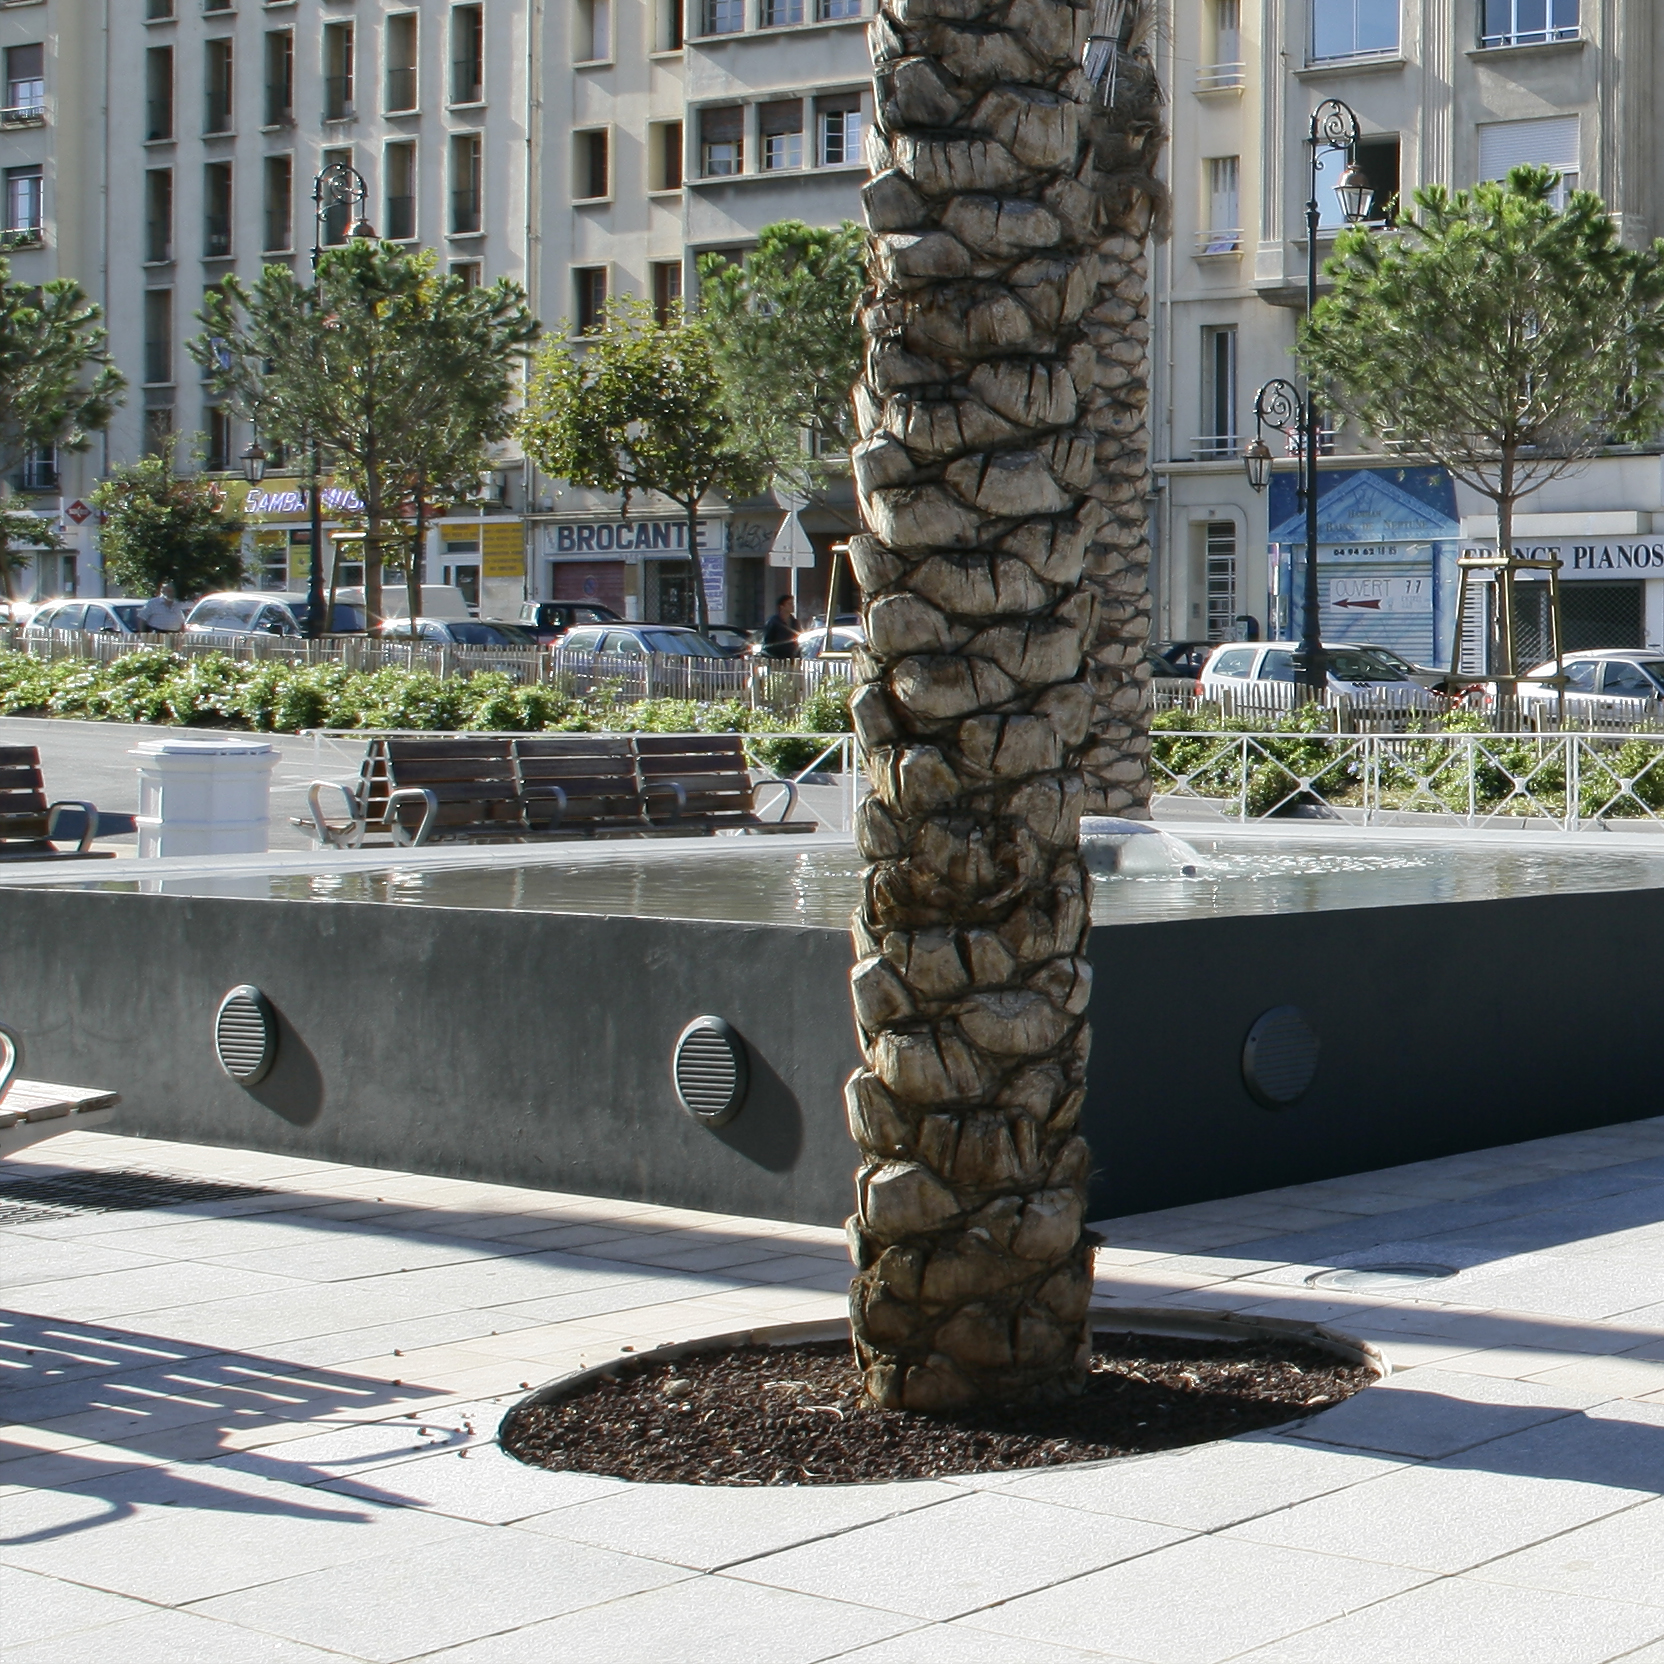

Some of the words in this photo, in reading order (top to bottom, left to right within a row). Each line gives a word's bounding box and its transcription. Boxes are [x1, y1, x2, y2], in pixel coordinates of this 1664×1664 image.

[558, 520, 707, 552] BROCANTE
[1572, 544, 1664, 570] PIANOS
[1336, 579, 1391, 596] OUVERT
